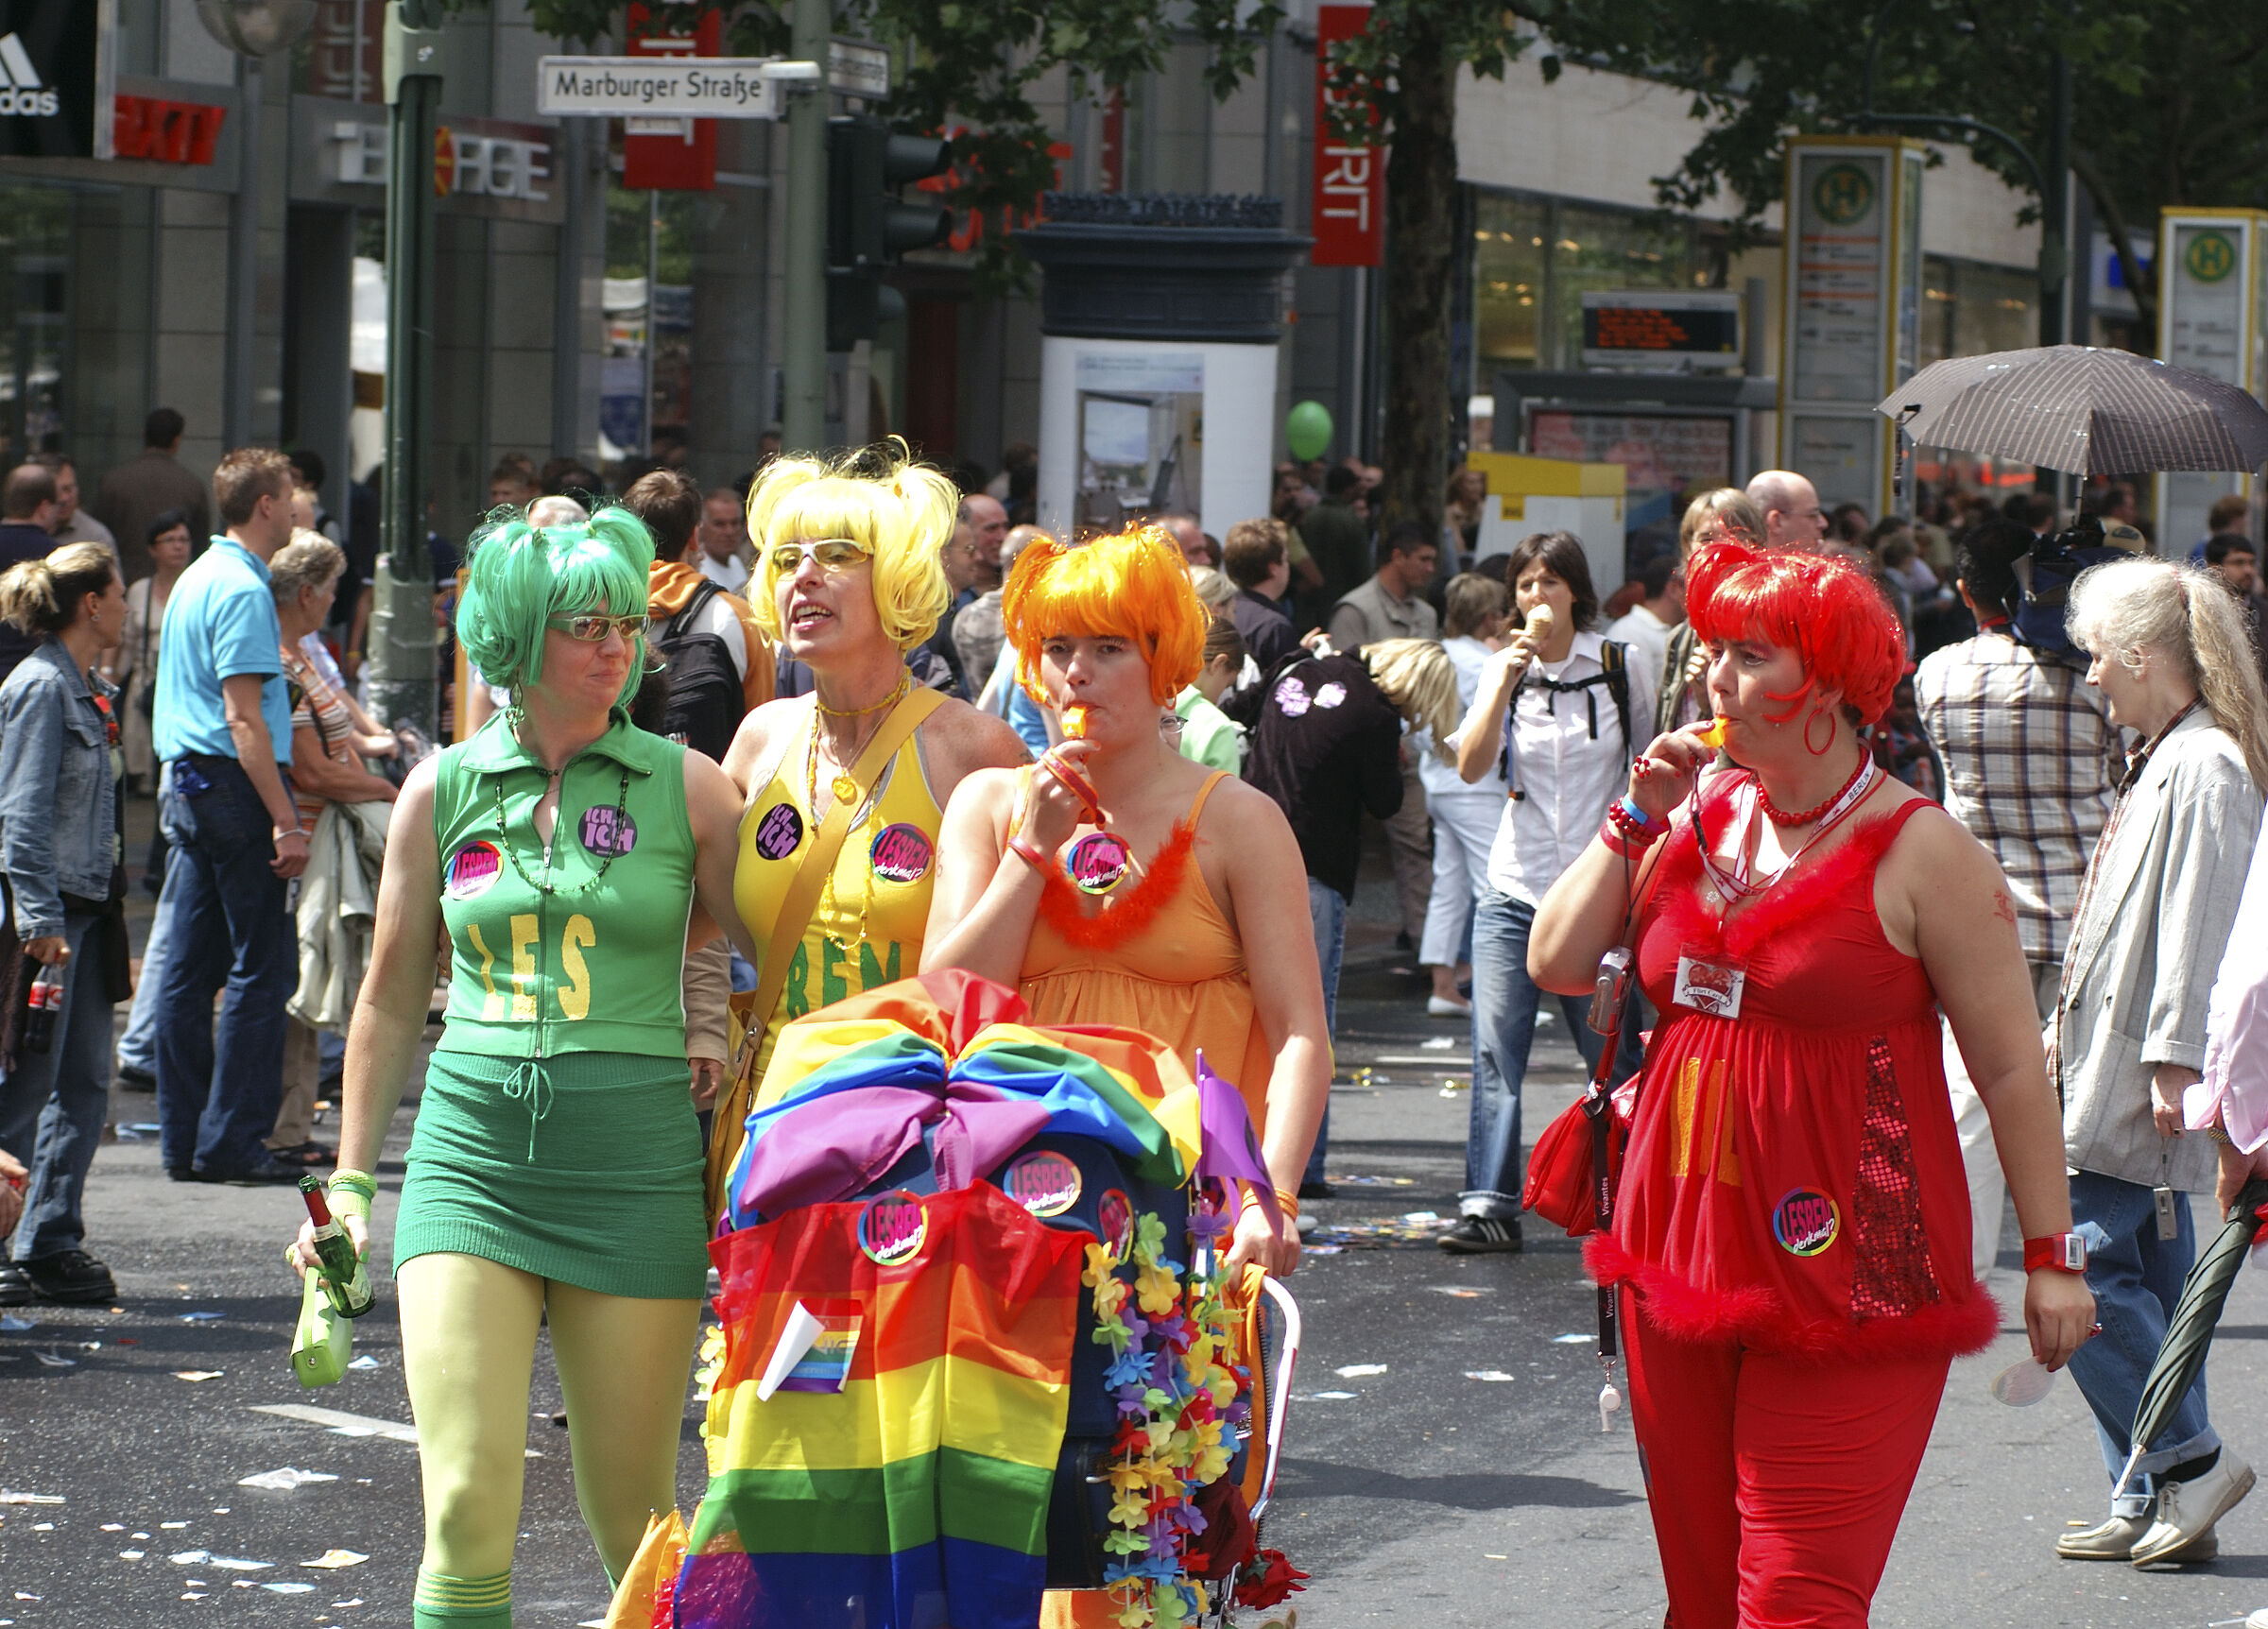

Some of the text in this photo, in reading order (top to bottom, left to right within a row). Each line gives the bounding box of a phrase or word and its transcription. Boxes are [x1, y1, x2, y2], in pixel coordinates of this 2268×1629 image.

[556, 71, 762, 104] Marburger Straße
[1847, 771, 1870, 800] BERLIN
[585, 807, 613, 824] ICH
[771, 803, 794, 826] ICH
[584, 822, 634, 852] ICH
[757, 816, 798, 859] ICH
[467, 913, 596, 1021] LES
[1601, 1176, 1610, 1217] Vivantes
[1780, 1196, 1831, 1246] LESBEN
